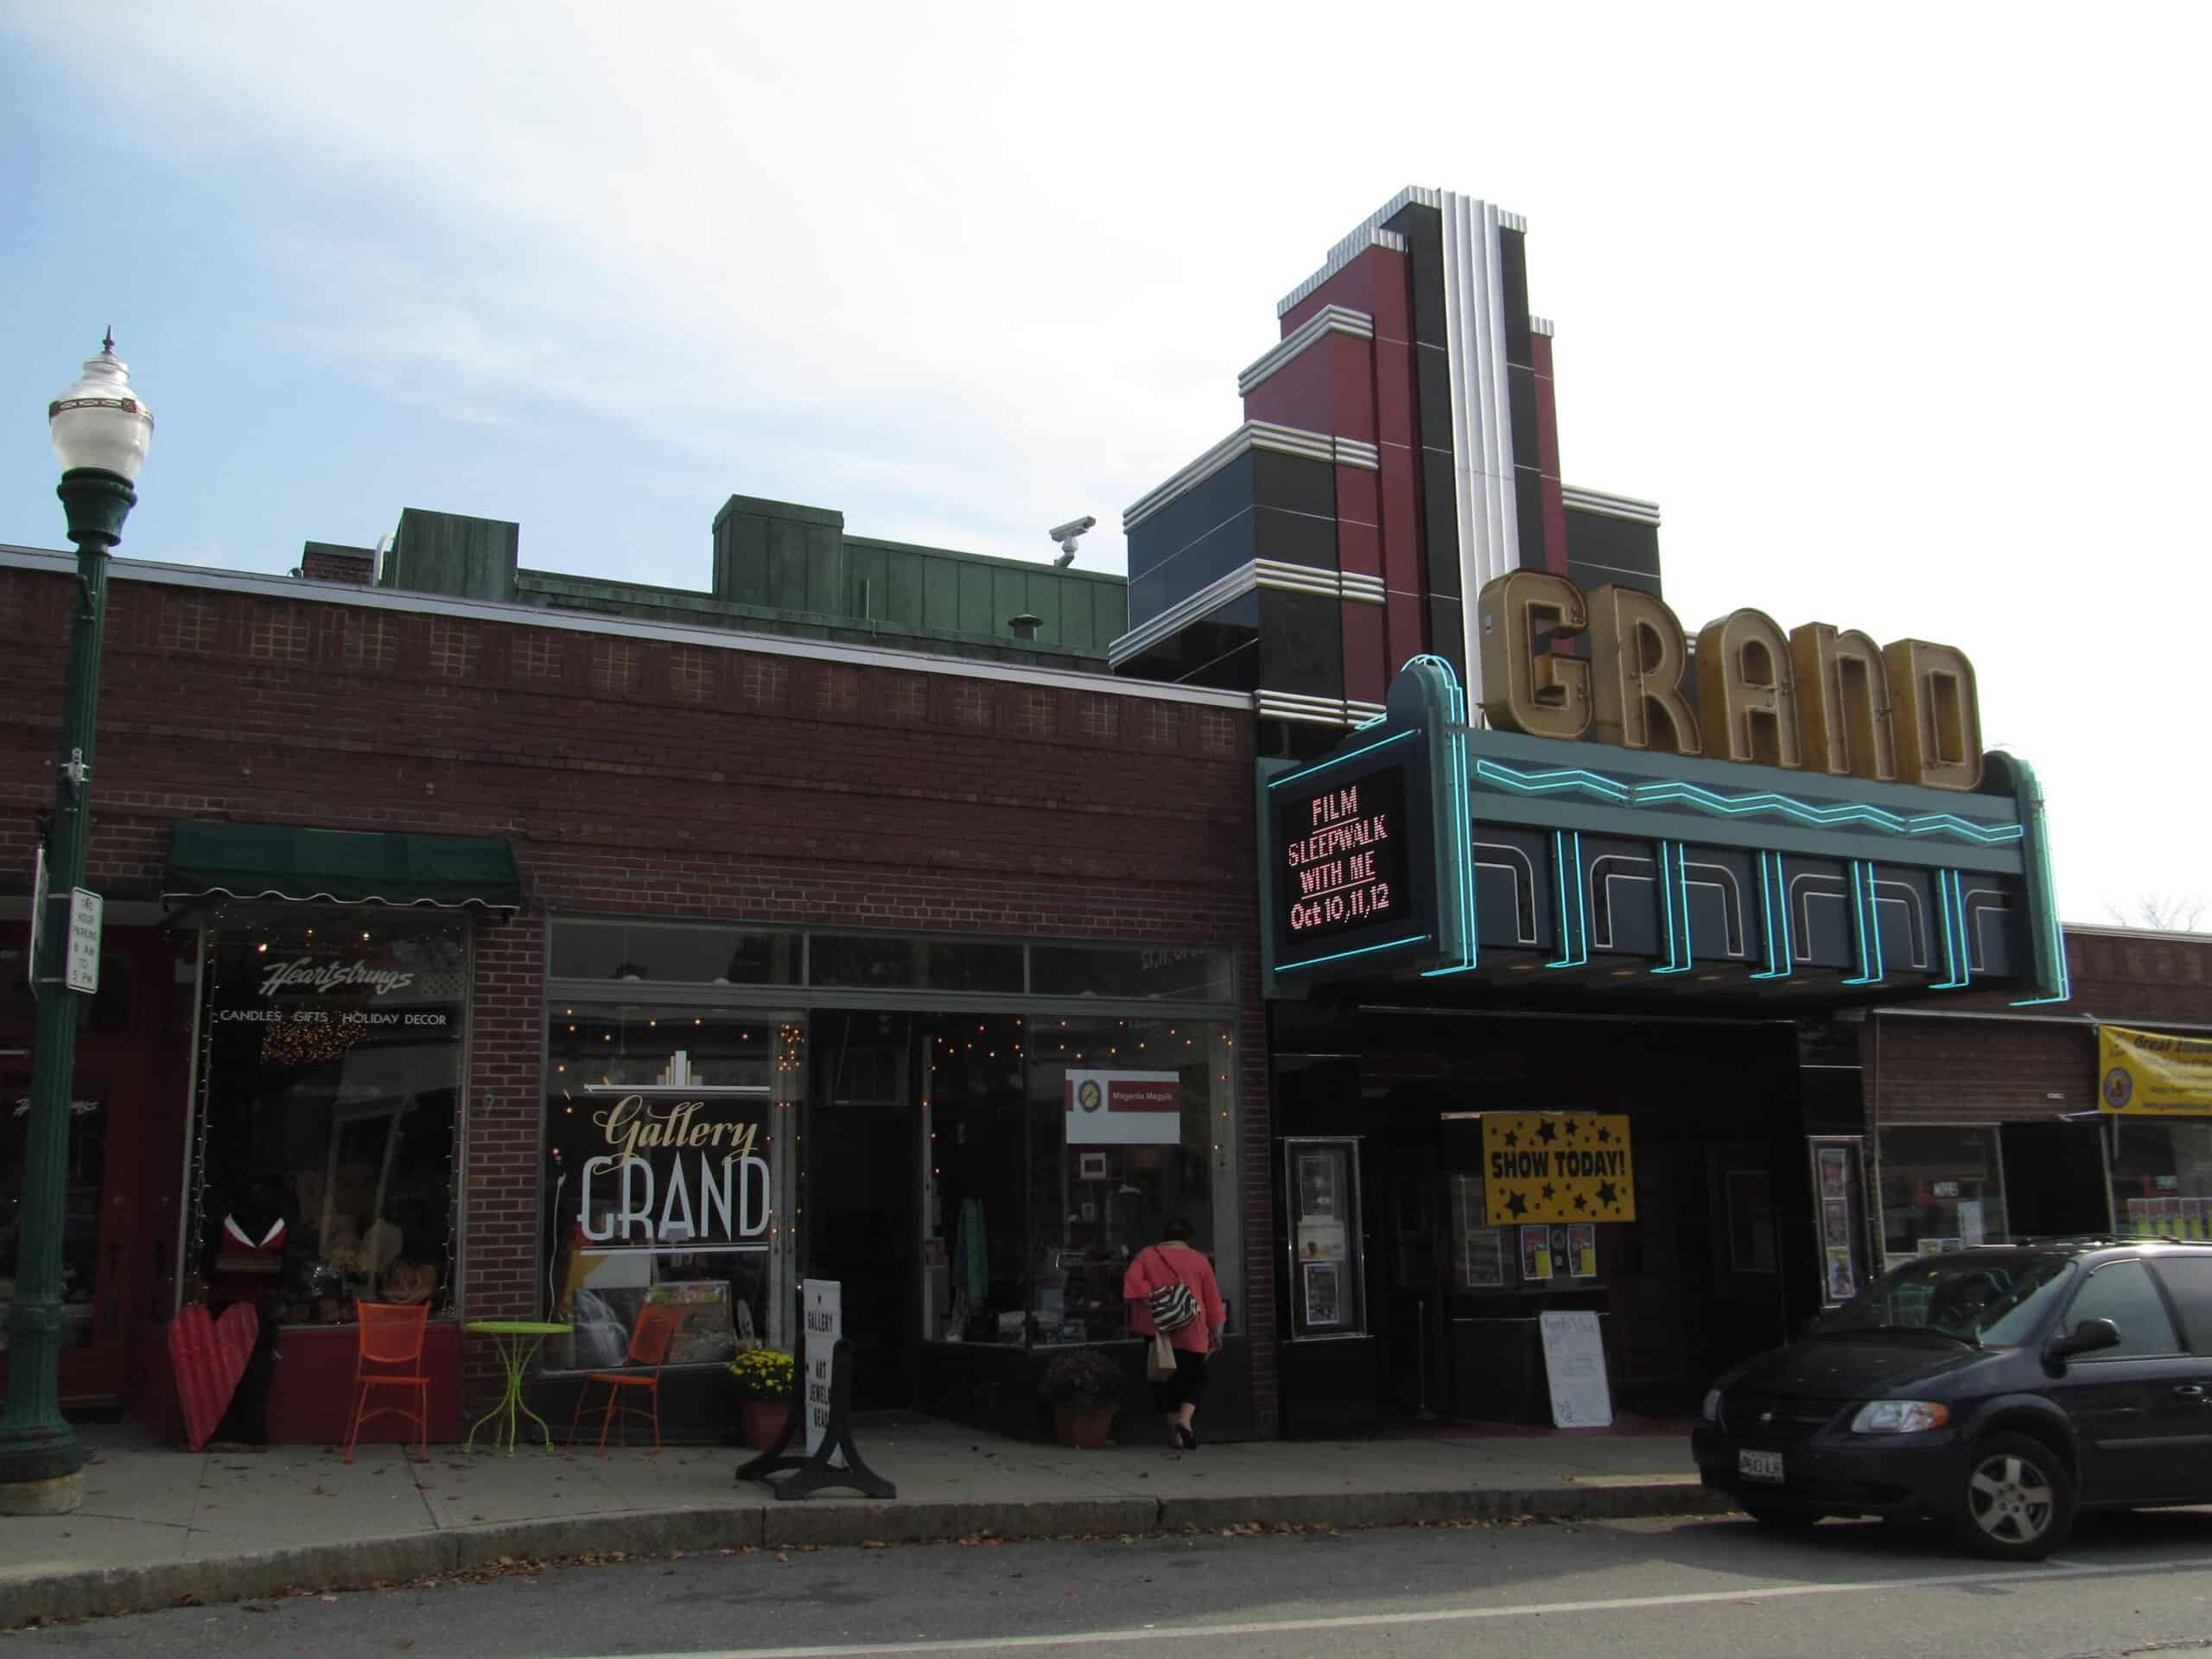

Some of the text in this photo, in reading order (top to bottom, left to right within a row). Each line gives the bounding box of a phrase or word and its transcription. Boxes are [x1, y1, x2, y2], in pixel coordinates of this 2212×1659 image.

[1478, 569, 1984, 791] GRAND
[1312, 785, 1359, 826] FILM
[1287, 815, 1389, 868] SLEEPWALK
[1300, 850, 1376, 893] WITH ME
[1290, 902, 1321, 930] Oct
[258, 956, 415, 996] Heartstrings
[220, 1009, 447, 1026] CANDLES GIFTS HOLIDAY DECOR
[593, 1095, 759, 1175] Gallery
[1491, 1150, 1626, 1179] SHOW TODAY!
[576, 1151, 772, 1243] GRAND
[808, 1311, 833, 1332] GALLERY
[816, 1361, 827, 1379] ART
